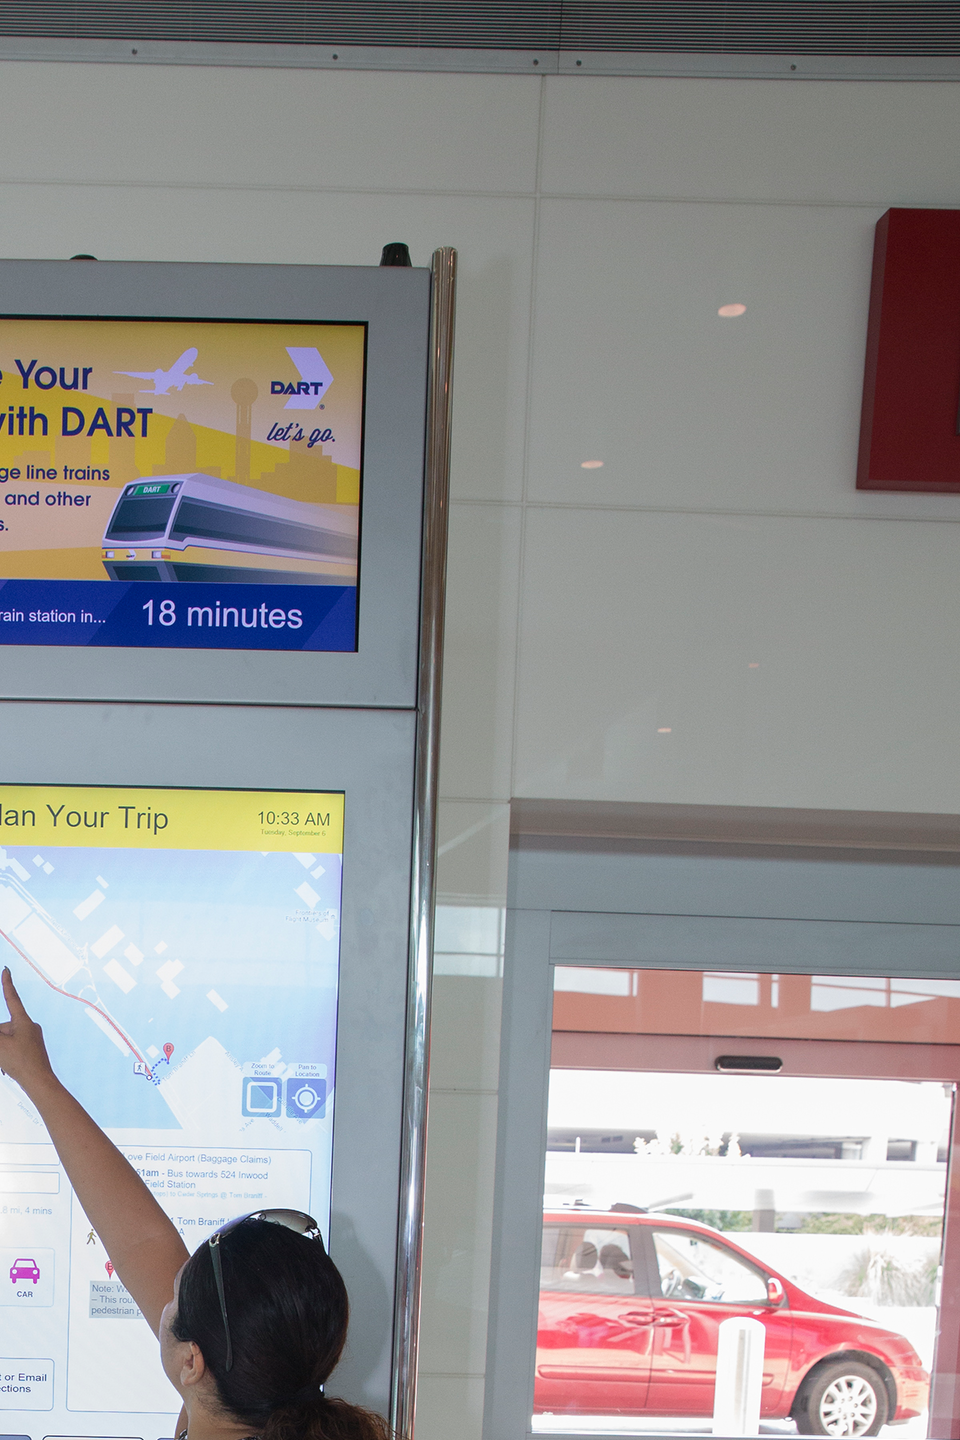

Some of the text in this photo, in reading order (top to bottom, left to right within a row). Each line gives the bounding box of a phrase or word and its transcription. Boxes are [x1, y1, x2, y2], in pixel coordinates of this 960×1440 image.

[14, 359, 92, 390] Your
[270, 381, 323, 396] DART
[61, 407, 153, 438] DART
[266, 422, 336, 448] let's go.
[26, 465, 57, 480] line
[62, 465, 110, 481] trains
[5, 490, 40, 506] and
[46, 491, 91, 506] other
[28, 609, 76, 623] station
[80, 609, 106, 624] in...
[141, 600, 303, 629] 18 minutes
[46, 804, 109, 828] Your
[118, 805, 169, 831] Trip
[258, 811, 330, 826] 10:33 AM
[146, 1153, 165, 1161] Field
[167, 1153, 195, 1163] Airport
[197, 1154, 238, 1165] (Baggage
[240, 1154, 272, 1165] Claims)
[167, 1169, 184, 1178] Bus
[185, 1170, 218, 1178] towards
[220, 1170, 236, 1179] 524
[238, 1171, 268, 1180] Inwood
[167, 1180, 196, 1189] Station
[10, 1206, 23, 1216] mi,
[25, 1207, 30, 1215] 4
[33, 1207, 53, 1215] mins
[177, 1217, 196, 1225] Tom
[198, 1218, 225, 1226] Braniff
[16, 1290, 34, 1299] CAR
[92, 1284, 114, 1292] Note:
[100, 1295, 117, 1303] This
[91, 1306, 134, 1315] pedestrian
[4, 1374, 15, 1382] or
[18, 1372, 48, 1383] Email
